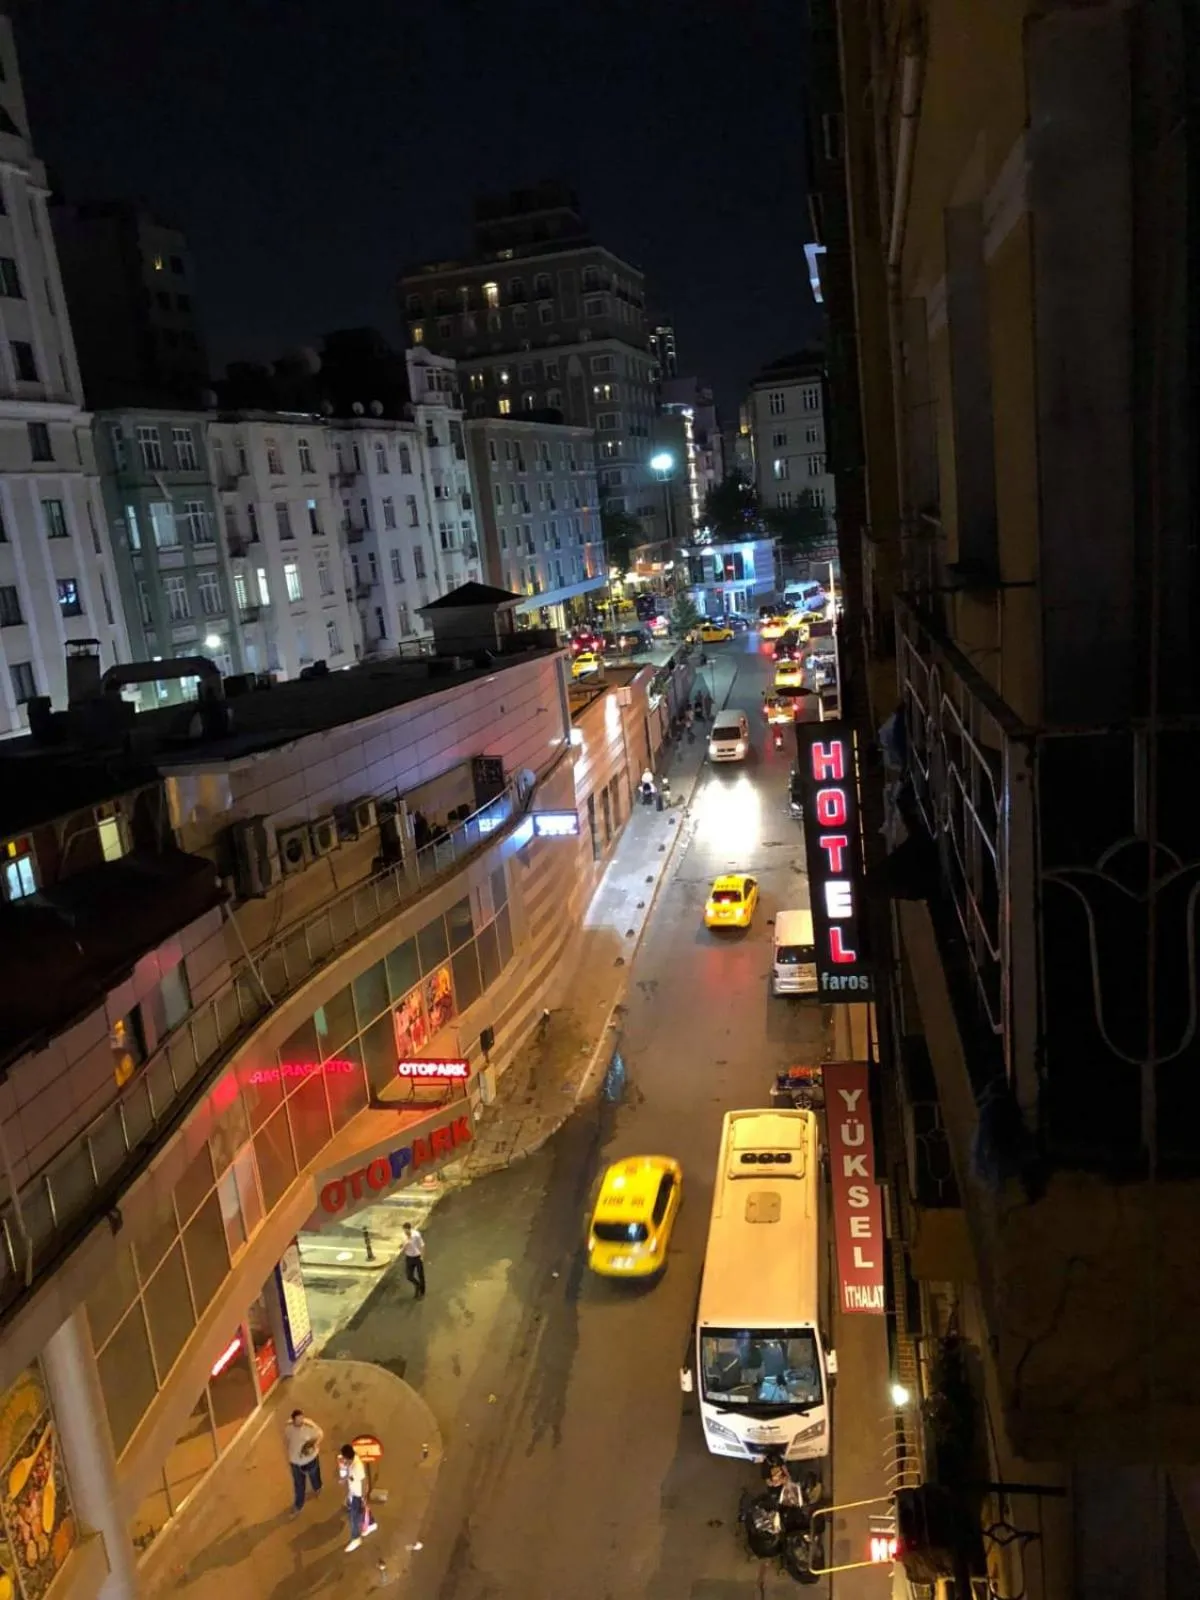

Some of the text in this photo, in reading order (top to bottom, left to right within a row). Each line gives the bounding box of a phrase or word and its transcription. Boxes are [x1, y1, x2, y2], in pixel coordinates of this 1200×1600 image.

[811, 740, 856, 963] HOTEL
[821, 972, 869, 990] faros
[398, 1062, 467, 1076] OTOPARK
[320, 1115, 472, 1214] OTOPARK
[838, 1089, 874, 1268] YÜKSEL
